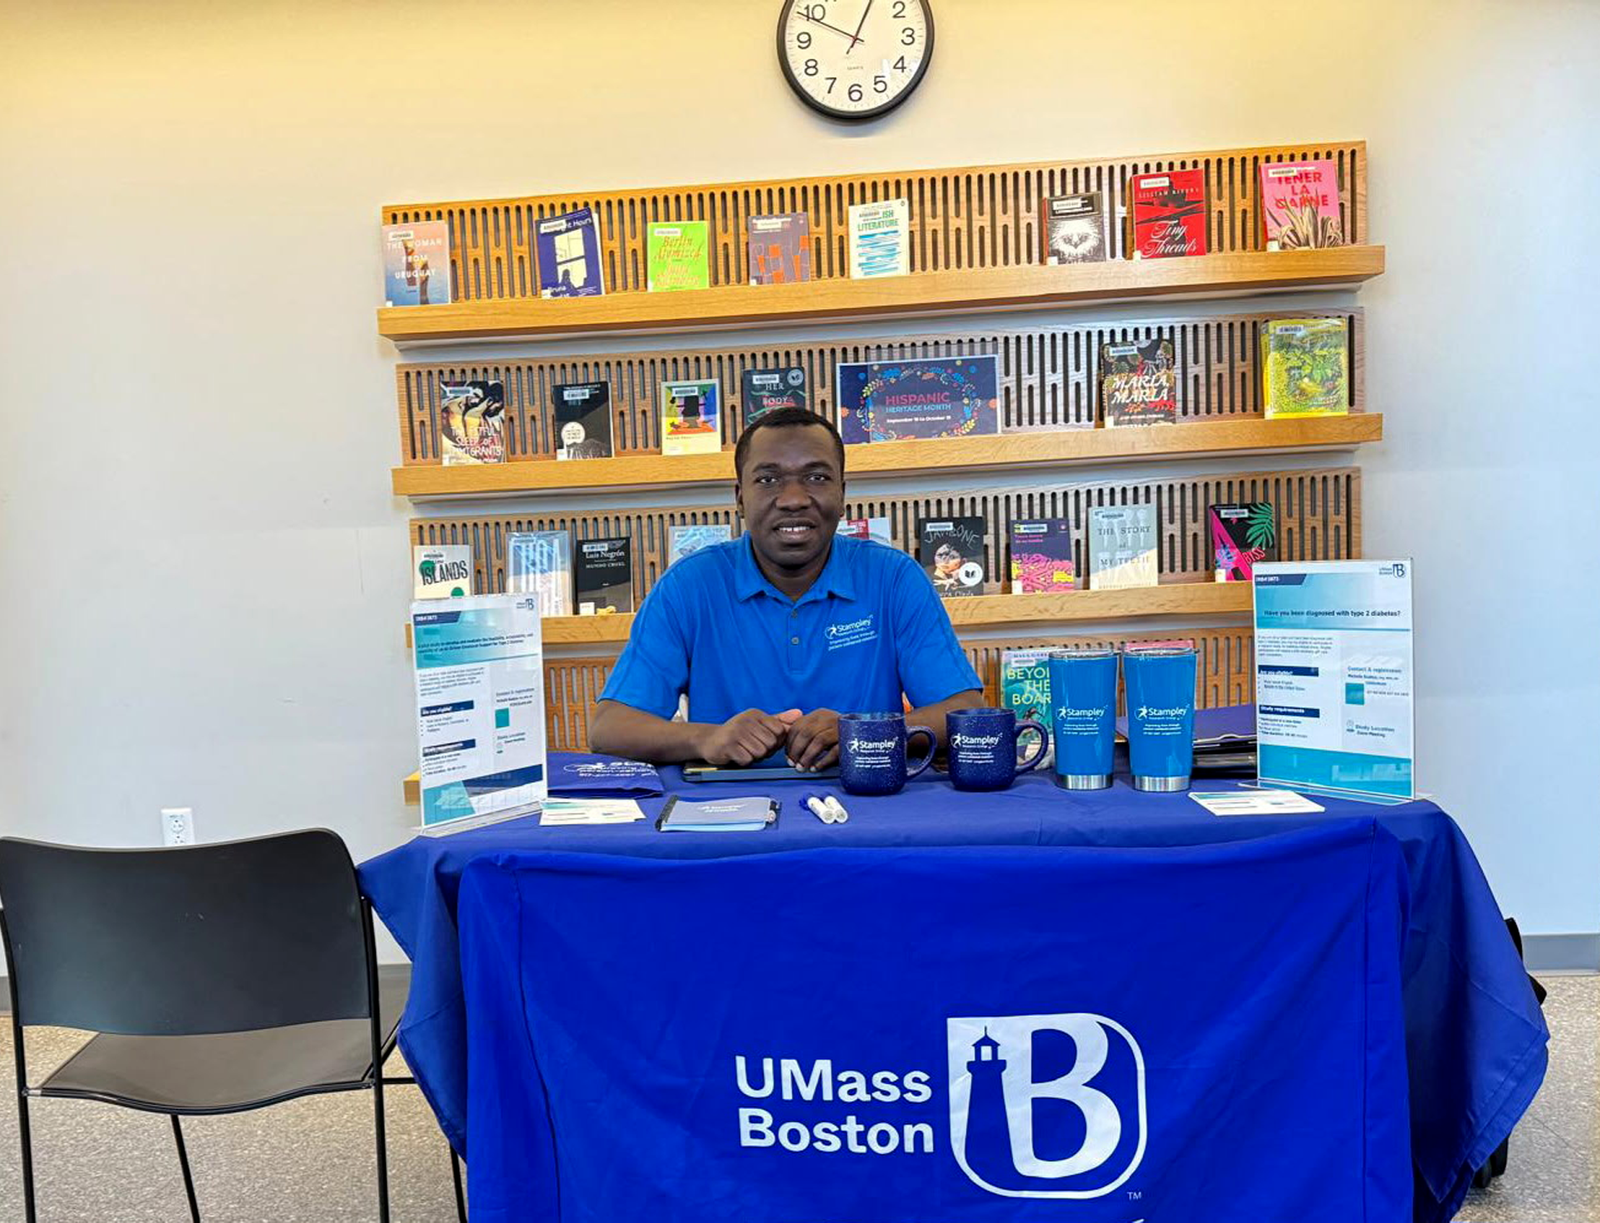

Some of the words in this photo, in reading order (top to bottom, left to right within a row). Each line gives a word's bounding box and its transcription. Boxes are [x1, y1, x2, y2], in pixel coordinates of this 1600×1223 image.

[803, 4, 826, 22] 10
[893, 1, 906, 19] 2
[796, 32, 812, 50] 9
[901, 27, 915, 46] 3
[804, 59, 819, 77] 8
[893, 56, 907, 73] 4
[825, 77, 837, 94] 7
[873, 75, 888, 94] 5
[848, 84, 863, 102] 6
[1291, 184, 1310, 196] LA
[857, 218, 899, 232] LITERATURE
[1150, 220, 1188, 241] Tiny
[1141, 237, 1197, 258] Threads
[765, 382, 785, 391] HER
[762, 396, 789, 405] BODY
[886, 392, 950, 406] HISPANIC
[886, 405, 923, 413] HERITAGE
[923, 403, 952, 412] MONTH
[1120, 525, 1151, 534] STORY
[421, 560, 469, 586] ISLANDS
[1263, 609, 1279, 617] Have
[1290, 609, 1305, 617] been
[1305, 609, 1336, 618] diagnosed
[1336, 609, 1350, 617] with
[1350, 610, 1365, 618] type
[1365, 609, 1371, 617] 2
[1371, 609, 1401, 617] diabetes?
[1024, 679, 1051, 692] THE
[1067, 706, 1105, 717] Stampley
[1148, 706, 1187, 717] Stampley
[859, 739, 896, 750] Stampley
[962, 735, 1000, 746] Stampley
[735, 1055, 932, 1103] UMass
[738, 1107, 934, 1155] Boston
[1127, 1192, 1142, 1200] TM
